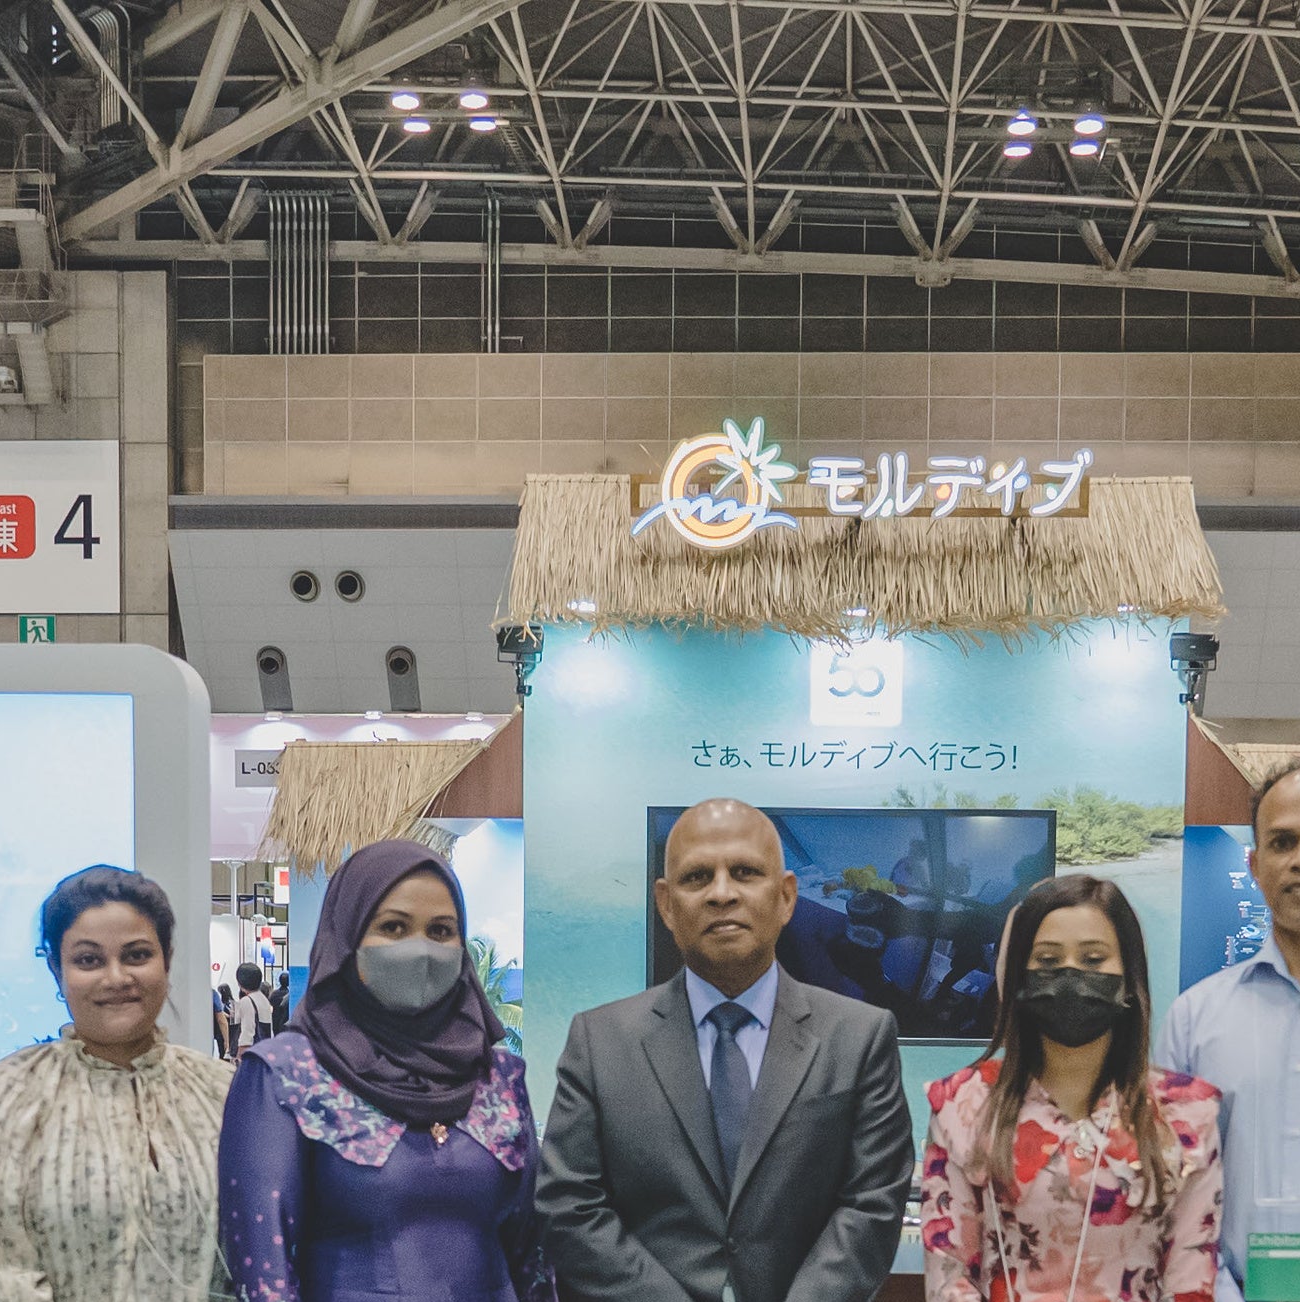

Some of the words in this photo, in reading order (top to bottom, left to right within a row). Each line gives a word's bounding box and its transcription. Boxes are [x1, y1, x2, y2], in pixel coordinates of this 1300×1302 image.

[809, 448, 1094, 518] モルディブ
[54, 494, 100, 560] 4
